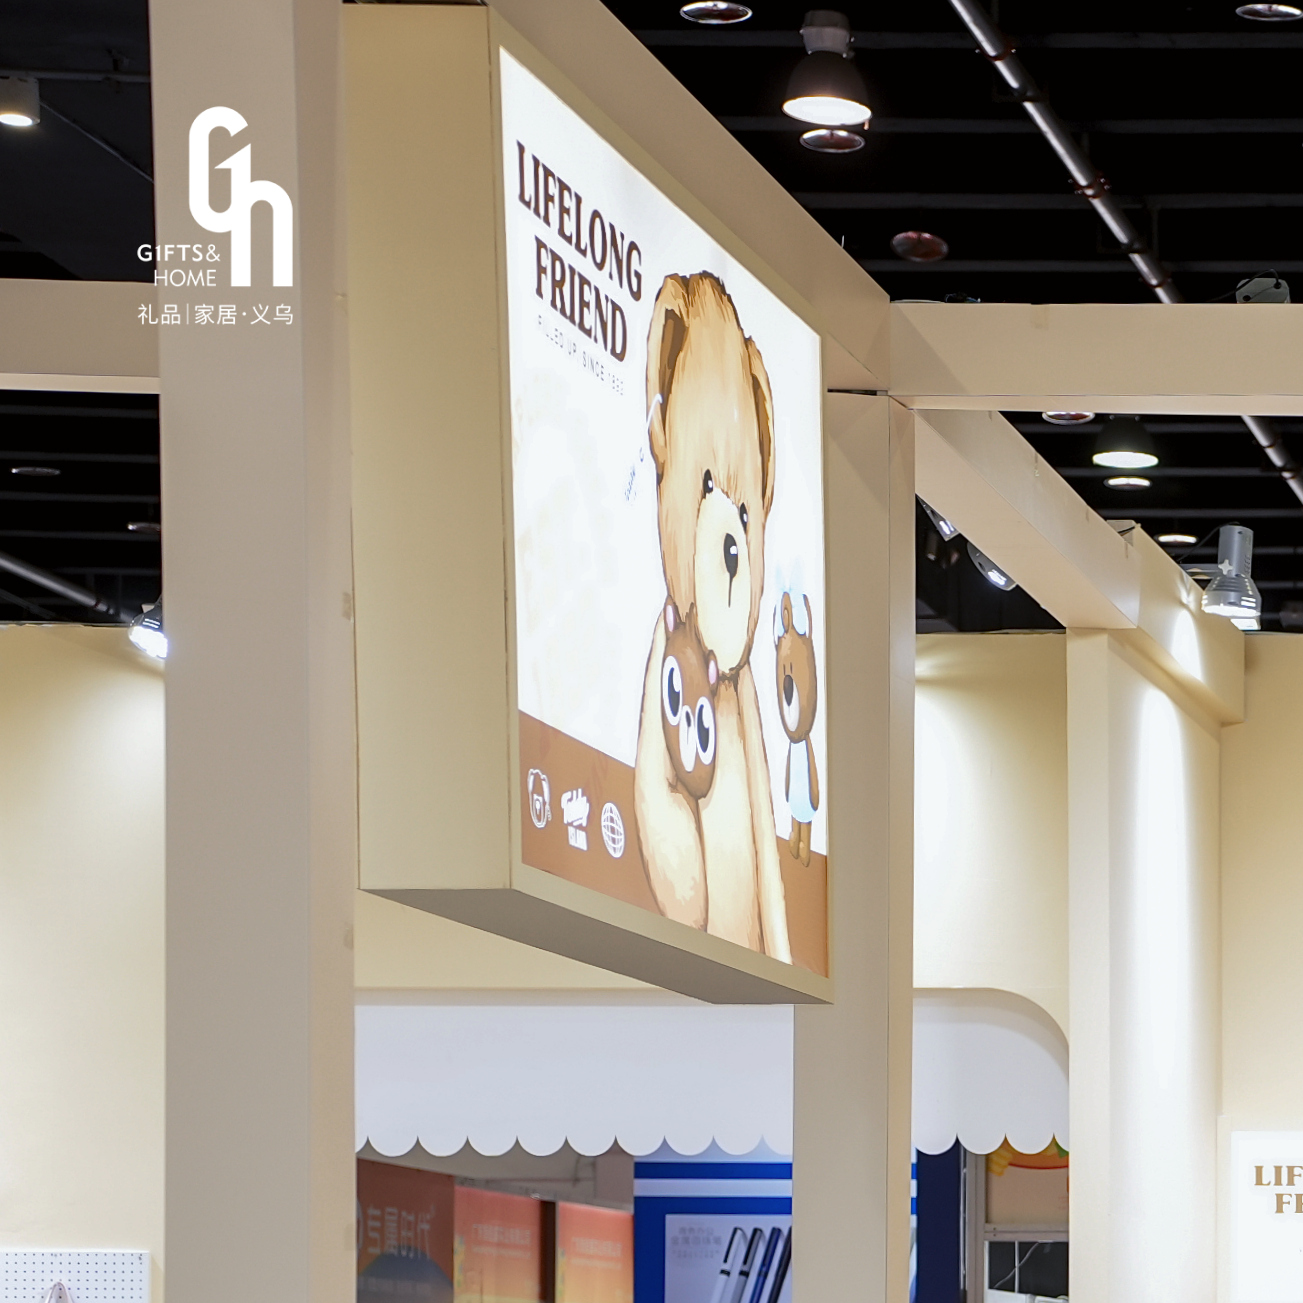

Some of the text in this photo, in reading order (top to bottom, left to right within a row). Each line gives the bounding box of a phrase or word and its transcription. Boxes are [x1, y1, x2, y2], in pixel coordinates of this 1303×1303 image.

[516, 139, 642, 302] LIFELONG
[534, 234, 627, 362] FRIEND
[582, 351, 605, 382] SINCE
